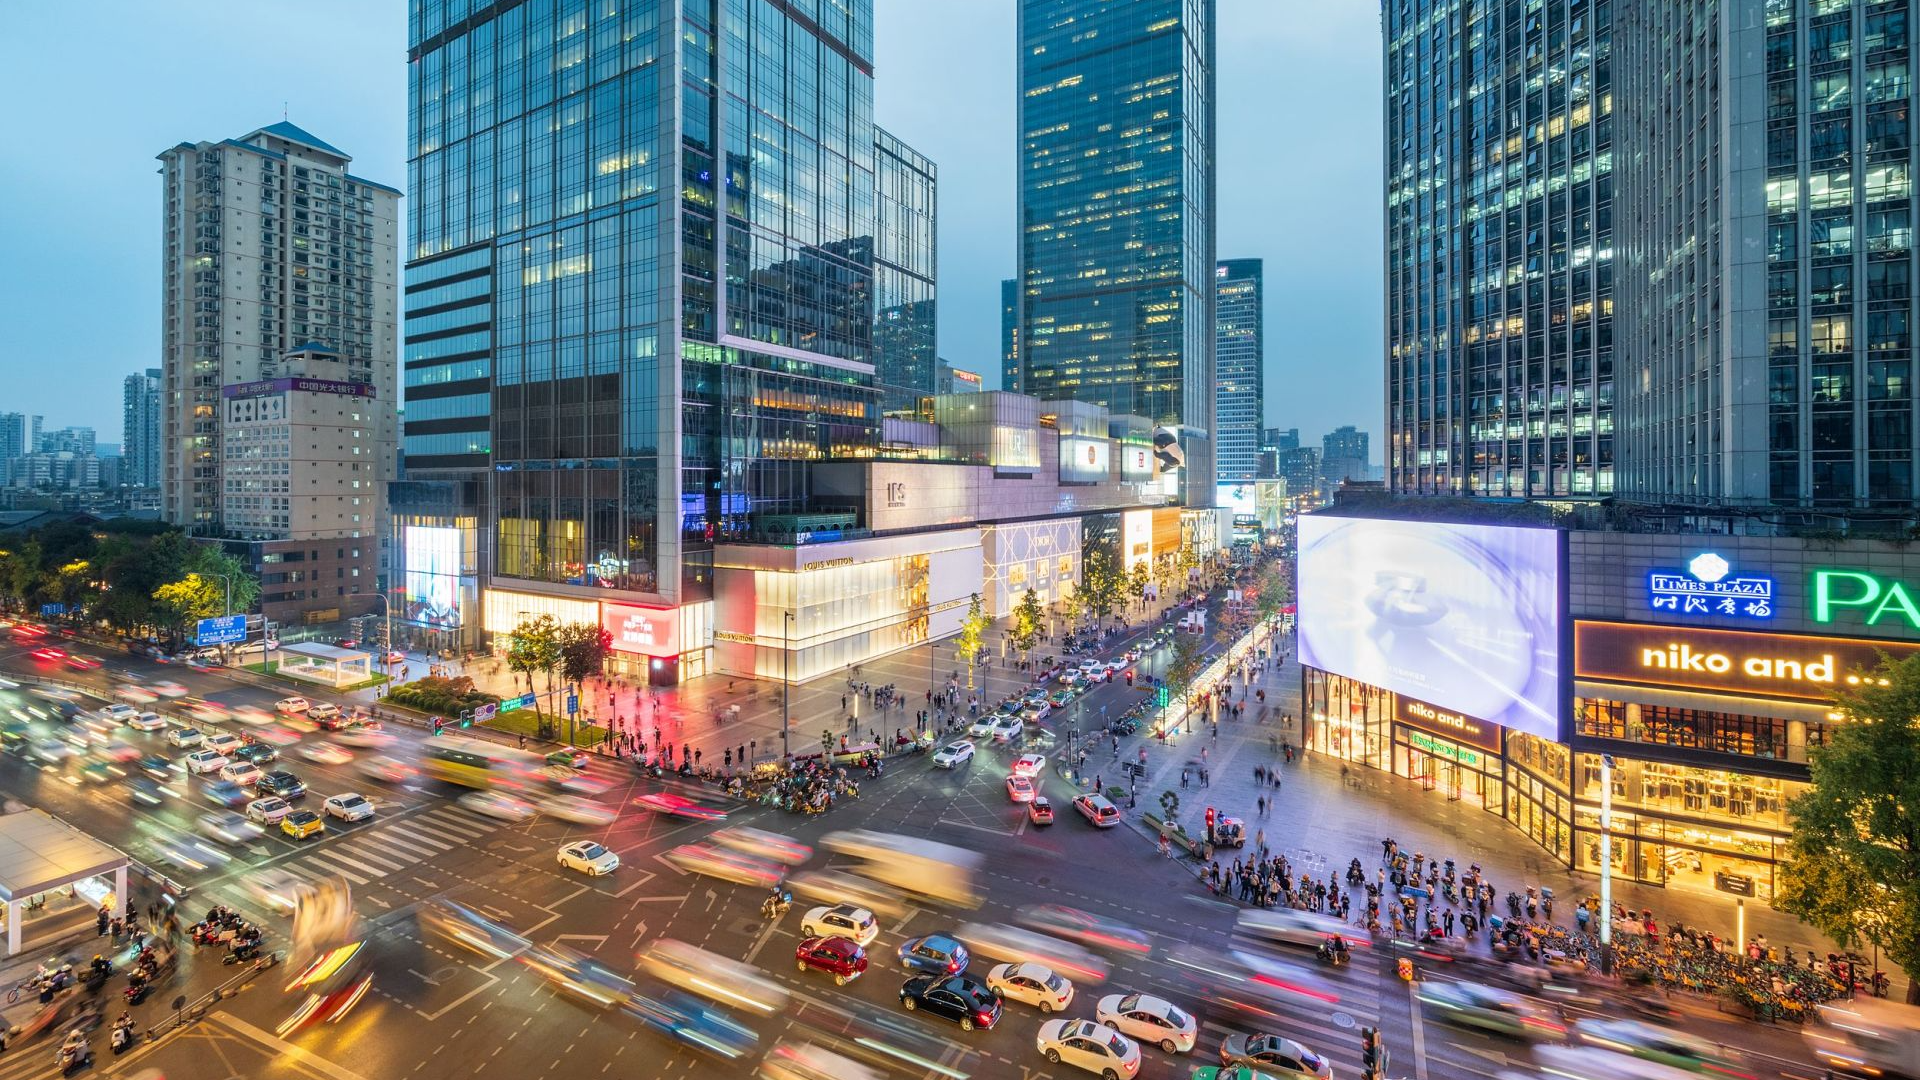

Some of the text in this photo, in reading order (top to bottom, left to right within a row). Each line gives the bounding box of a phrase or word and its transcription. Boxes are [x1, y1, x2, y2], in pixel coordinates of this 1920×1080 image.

[299, 381, 356, 394] 中国光大银行
[804, 556, 854, 571] LOUIS VUITTON
[1655, 578, 1766, 594] TIMES PLAZA
[716, 632, 754, 643] LOUIS VUITTON
[1643, 643, 1731, 673] niko
[1744, 654, 1834, 683] and
[1408, 703, 1436, 720] niko
[1438, 713, 1464, 728] and
[1412, 734, 1457, 757] PARKSON
[1684, 830, 1707, 840] niko
[1709, 834, 1732, 843] and
